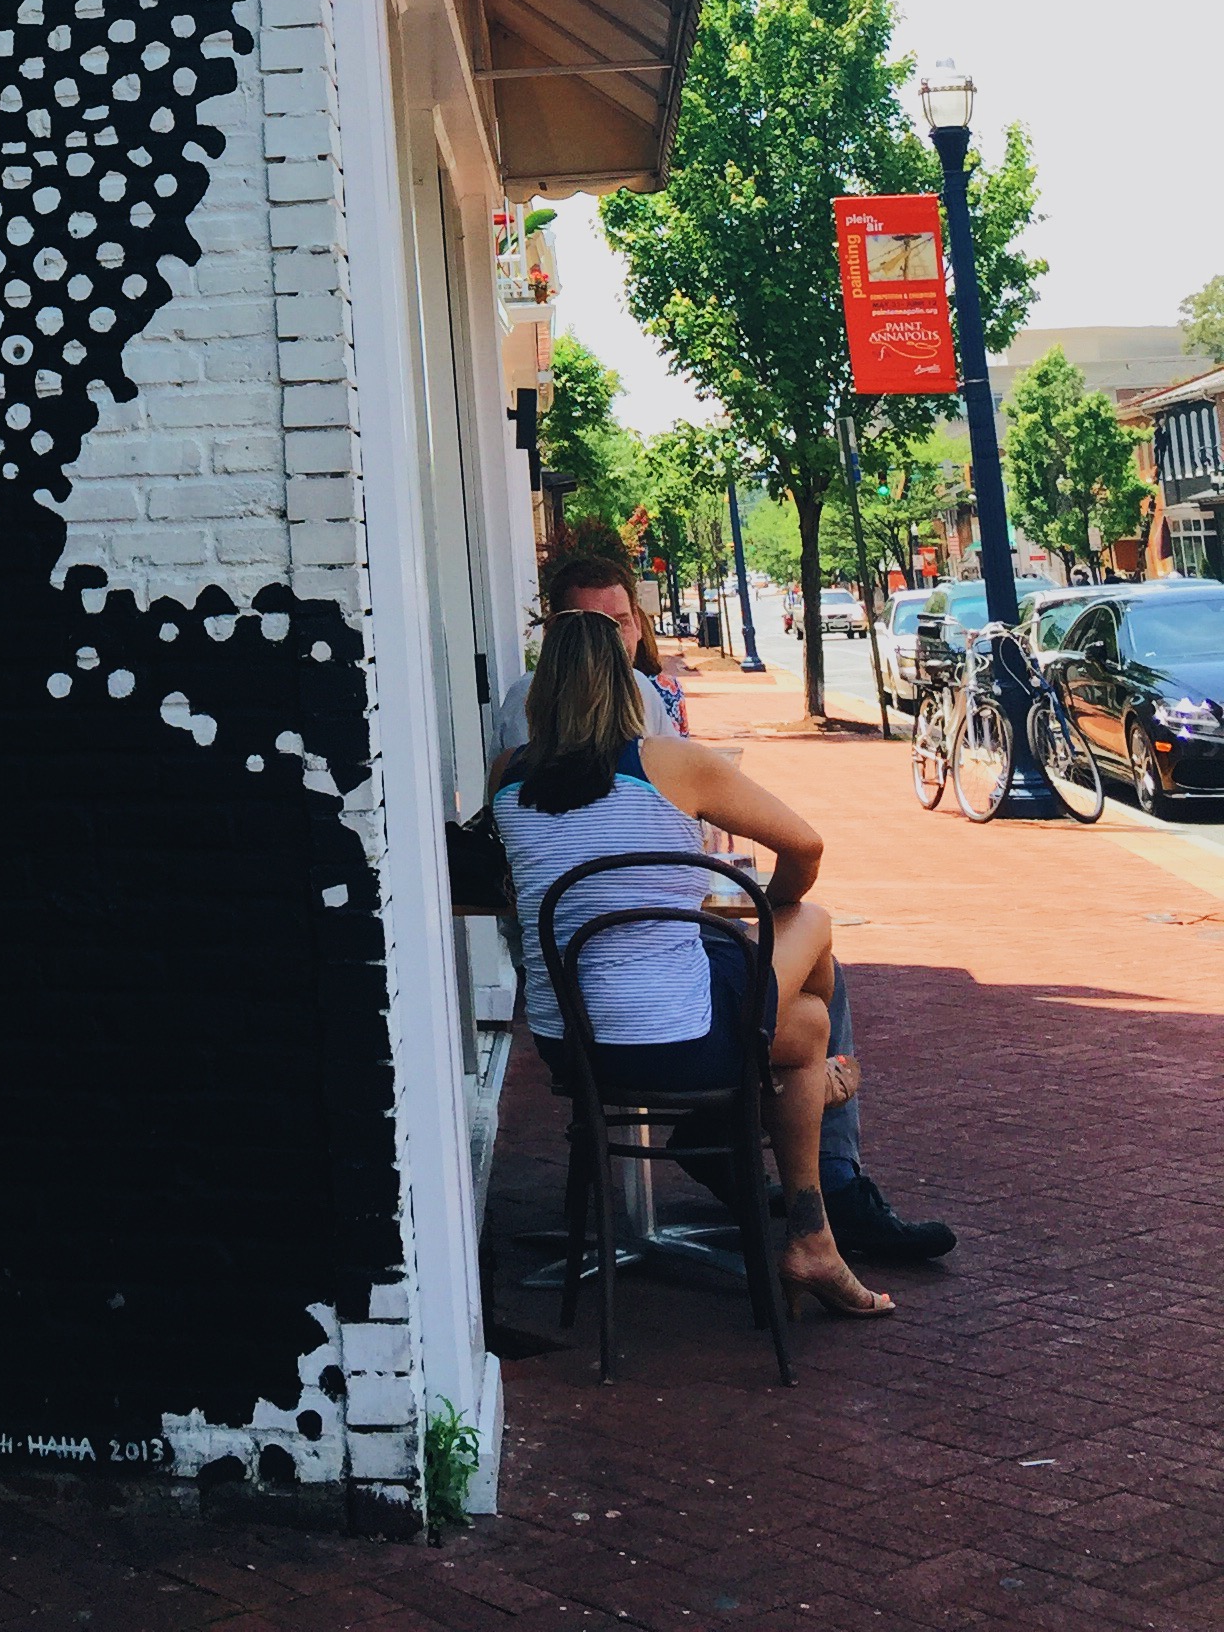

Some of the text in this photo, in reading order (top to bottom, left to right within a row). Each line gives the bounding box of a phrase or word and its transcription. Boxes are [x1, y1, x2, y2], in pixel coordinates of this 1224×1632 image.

[845, 213, 874, 226] plein
[865, 219, 884, 232] air
[844, 234, 867, 299] painting
[886, 322, 922, 332] PAINT
[870, 330, 941, 342] ANNAPOLIS
[109, 1438, 165, 1462] 2013
